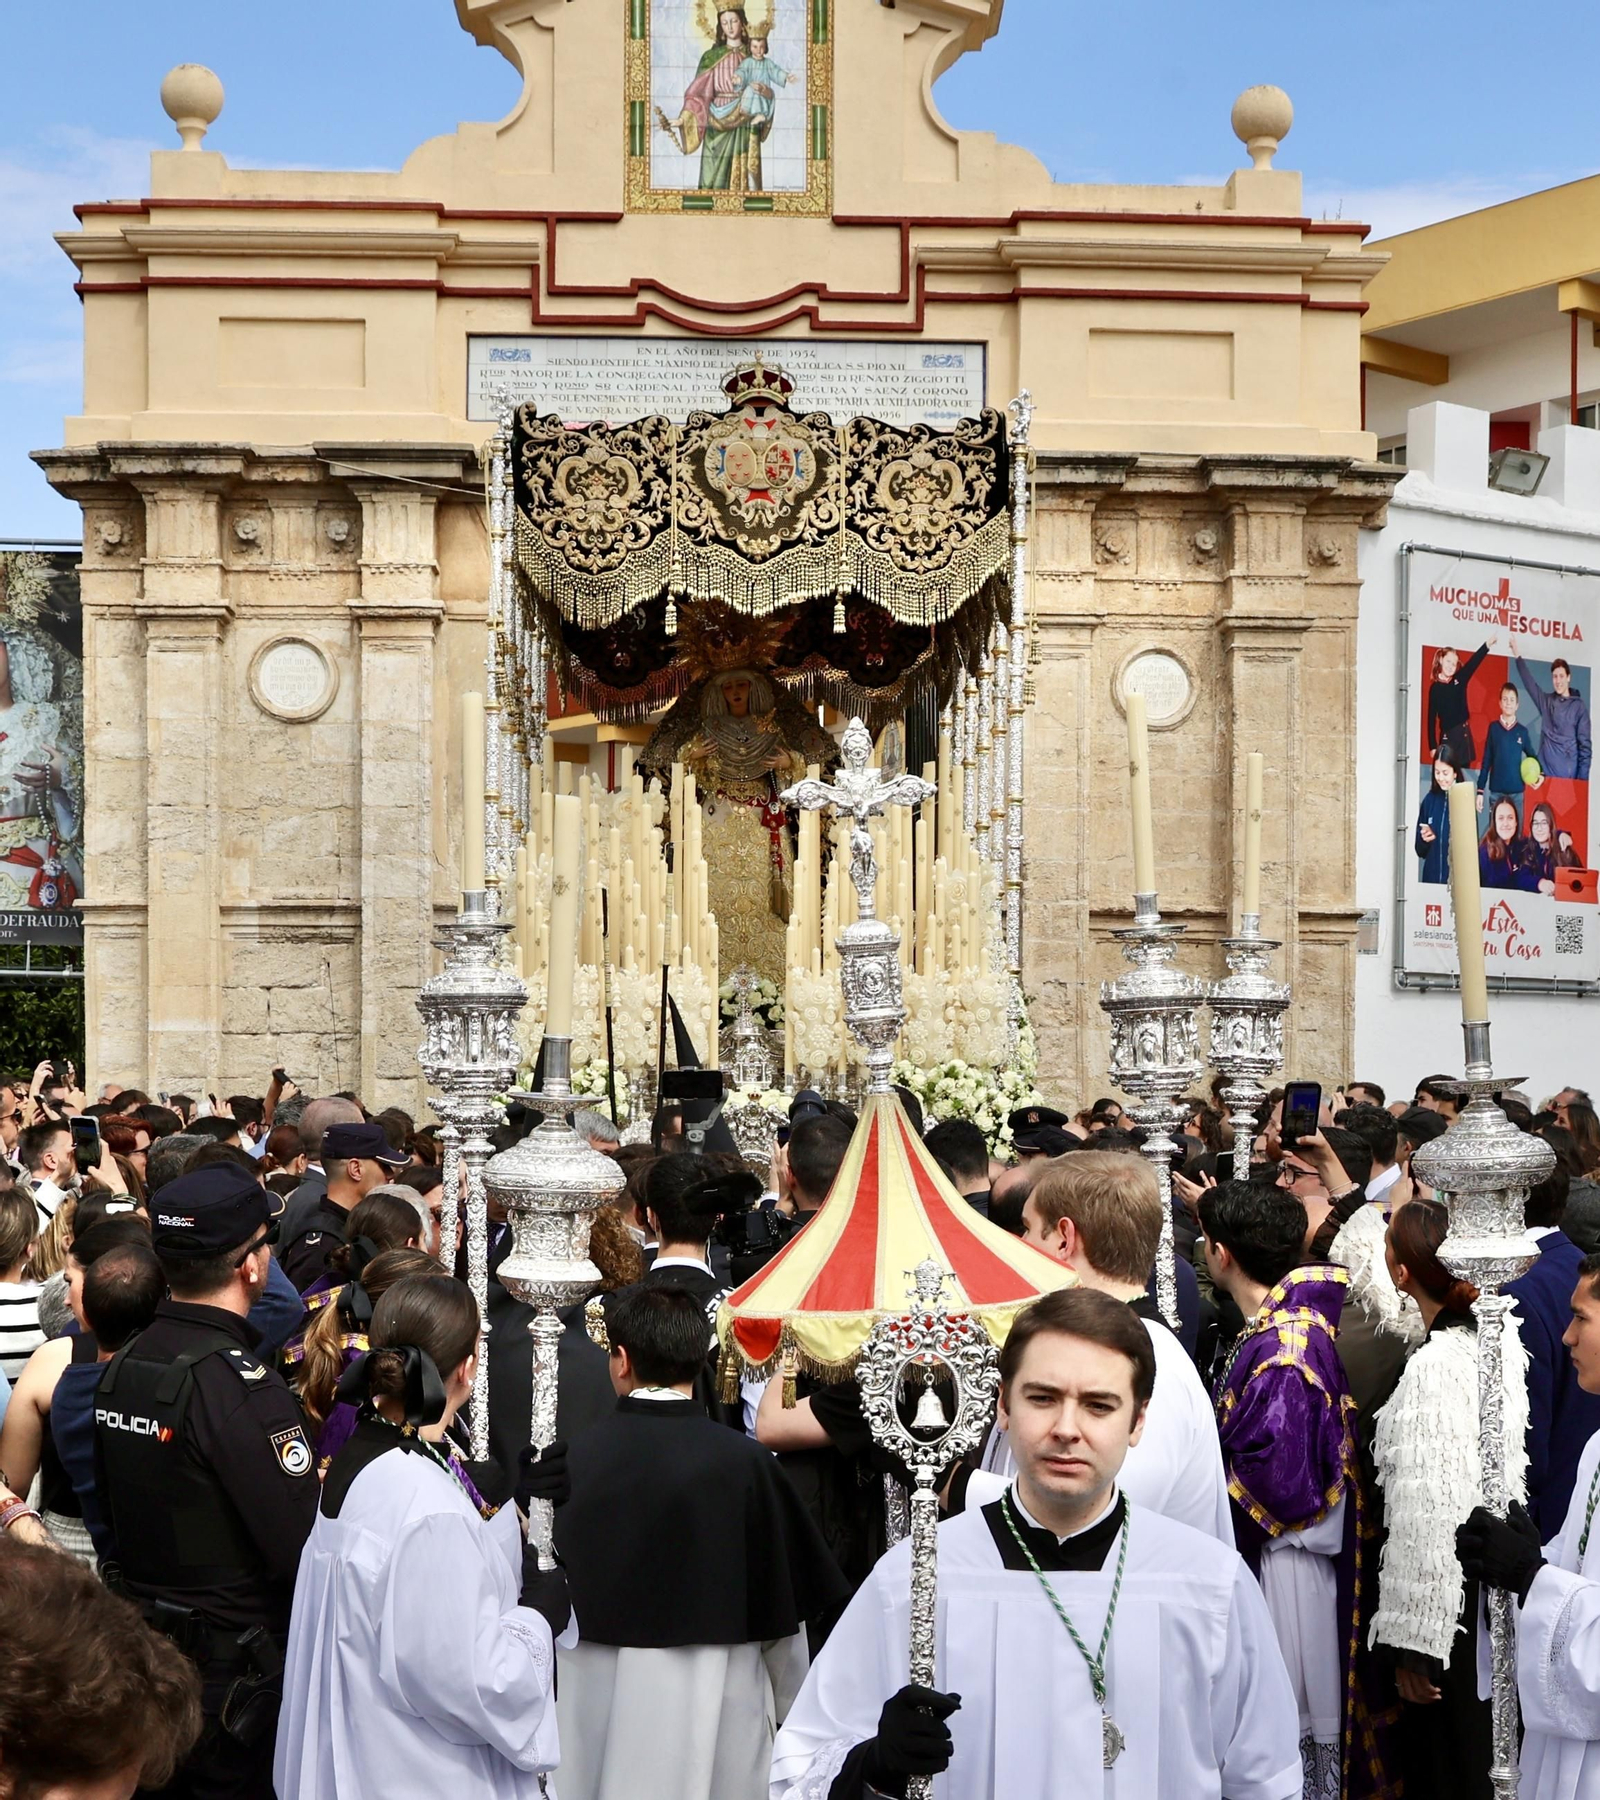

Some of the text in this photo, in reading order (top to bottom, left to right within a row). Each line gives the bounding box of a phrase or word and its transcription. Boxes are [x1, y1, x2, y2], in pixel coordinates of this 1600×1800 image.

[637, 347, 653, 355] EN
[656, 347, 670, 355] EL
[673, 346, 698, 356] AÑO
[701, 348, 724, 356] DEL
[767, 349, 783, 357] DE
[547, 358, 588, 366] SIENDO
[591, 358, 650, 367] PONTIFICE
[655, 360, 700, 368] MAXIMO
[703, 360, 717, 368] DE
[720, 361, 735, 369] LA
[786, 361, 842, 370] CATOLICA
[867, 363, 886, 371] PIO
[889, 363, 905, 371] XII
[511, 369, 553, 379] MAYOR
[556, 370, 573, 378] DE
[576, 370, 593, 379] LA
[597, 370, 692, 380] CONGREGACION
[850, 374, 900, 384] RENATO
[903, 375, 965, 384] ZIGGIOTTI
[480, 381, 497, 389] EL
[542, 381, 551, 390] Y
[616, 383, 688, 392] CARDENAL
[795, 386, 847, 395] SEGURA
[851, 386, 859, 394] Y
[864, 387, 908, 396] SAENZ
[913, 387, 969, 396] CORONO
[538, 394, 546, 402] Y
[551, 394, 640, 403] SOLEMNEMENTE
[644, 395, 659, 403] EL
[663, 396, 682, 404] DIA
[701, 396, 716, 404] DE
[817, 398, 830, 406] DE
[834, 397, 870, 407] MARIA
[875, 397, 948, 408] AUXILIADORA
[950, 399, 973, 408] QUE
[558, 406, 572, 414] SE
[576, 406, 621, 415] VENERA
[625, 407, 641, 415] EN
[644, 407, 657, 415] LA
[1429, 584, 1492, 610] MUCHO
[1452, 607, 1583, 642] QUE UNA ESCUELA
[0, 913, 80, 928] DEFRAUDA
[1413, 929, 1453, 941] salesianos
[1505, 933, 1543, 961] Casa
[158, 1214, 186, 1222] POLICIA
[158, 1219, 195, 1227] NACIONAL
[95, 1408, 160, 1437] POLICIA
